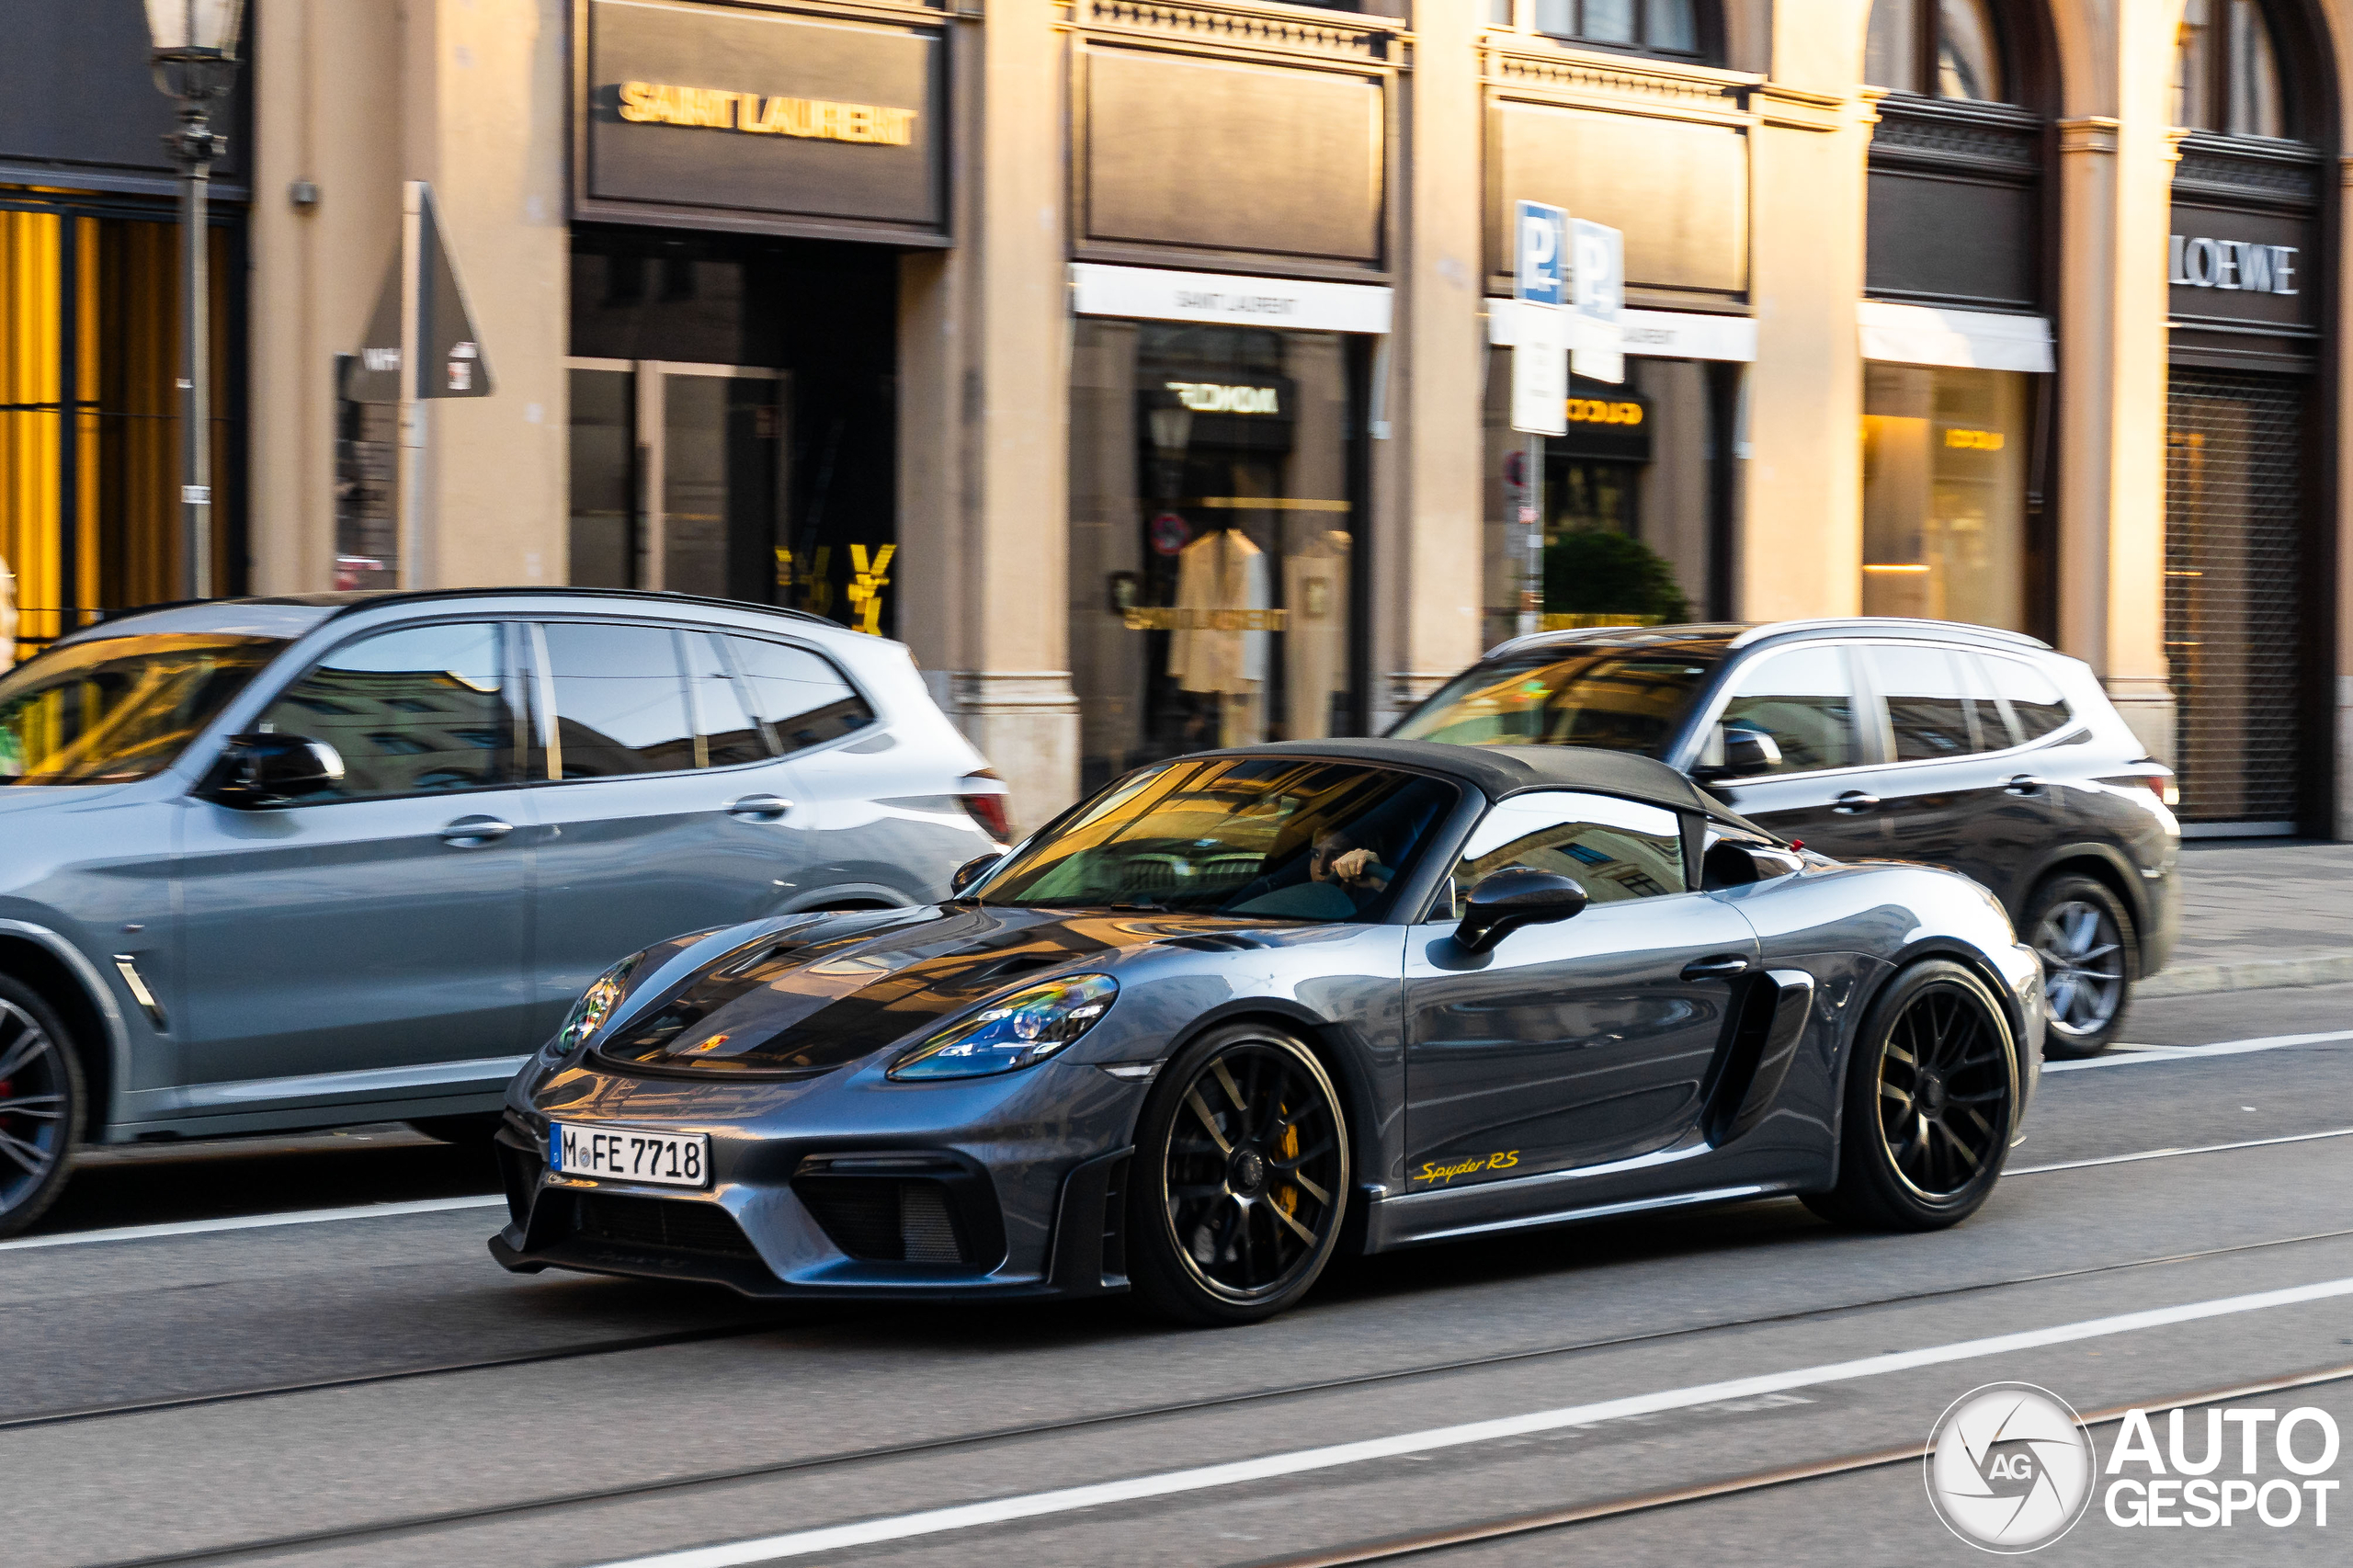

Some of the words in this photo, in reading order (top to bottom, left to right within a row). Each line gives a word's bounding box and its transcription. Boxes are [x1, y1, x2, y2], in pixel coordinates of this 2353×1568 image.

[737, 94, 917, 146] LAURENT
[1522, 215, 1556, 289] P
[2169, 234, 2300, 295] LOEWE
[563, 1131, 576, 1167] M
[593, 1134, 624, 1173] FE
[631, 1138, 700, 1179] 7718
[1414, 1158, 1485, 1184] Spyder
[1486, 1150, 1519, 1170] RS
